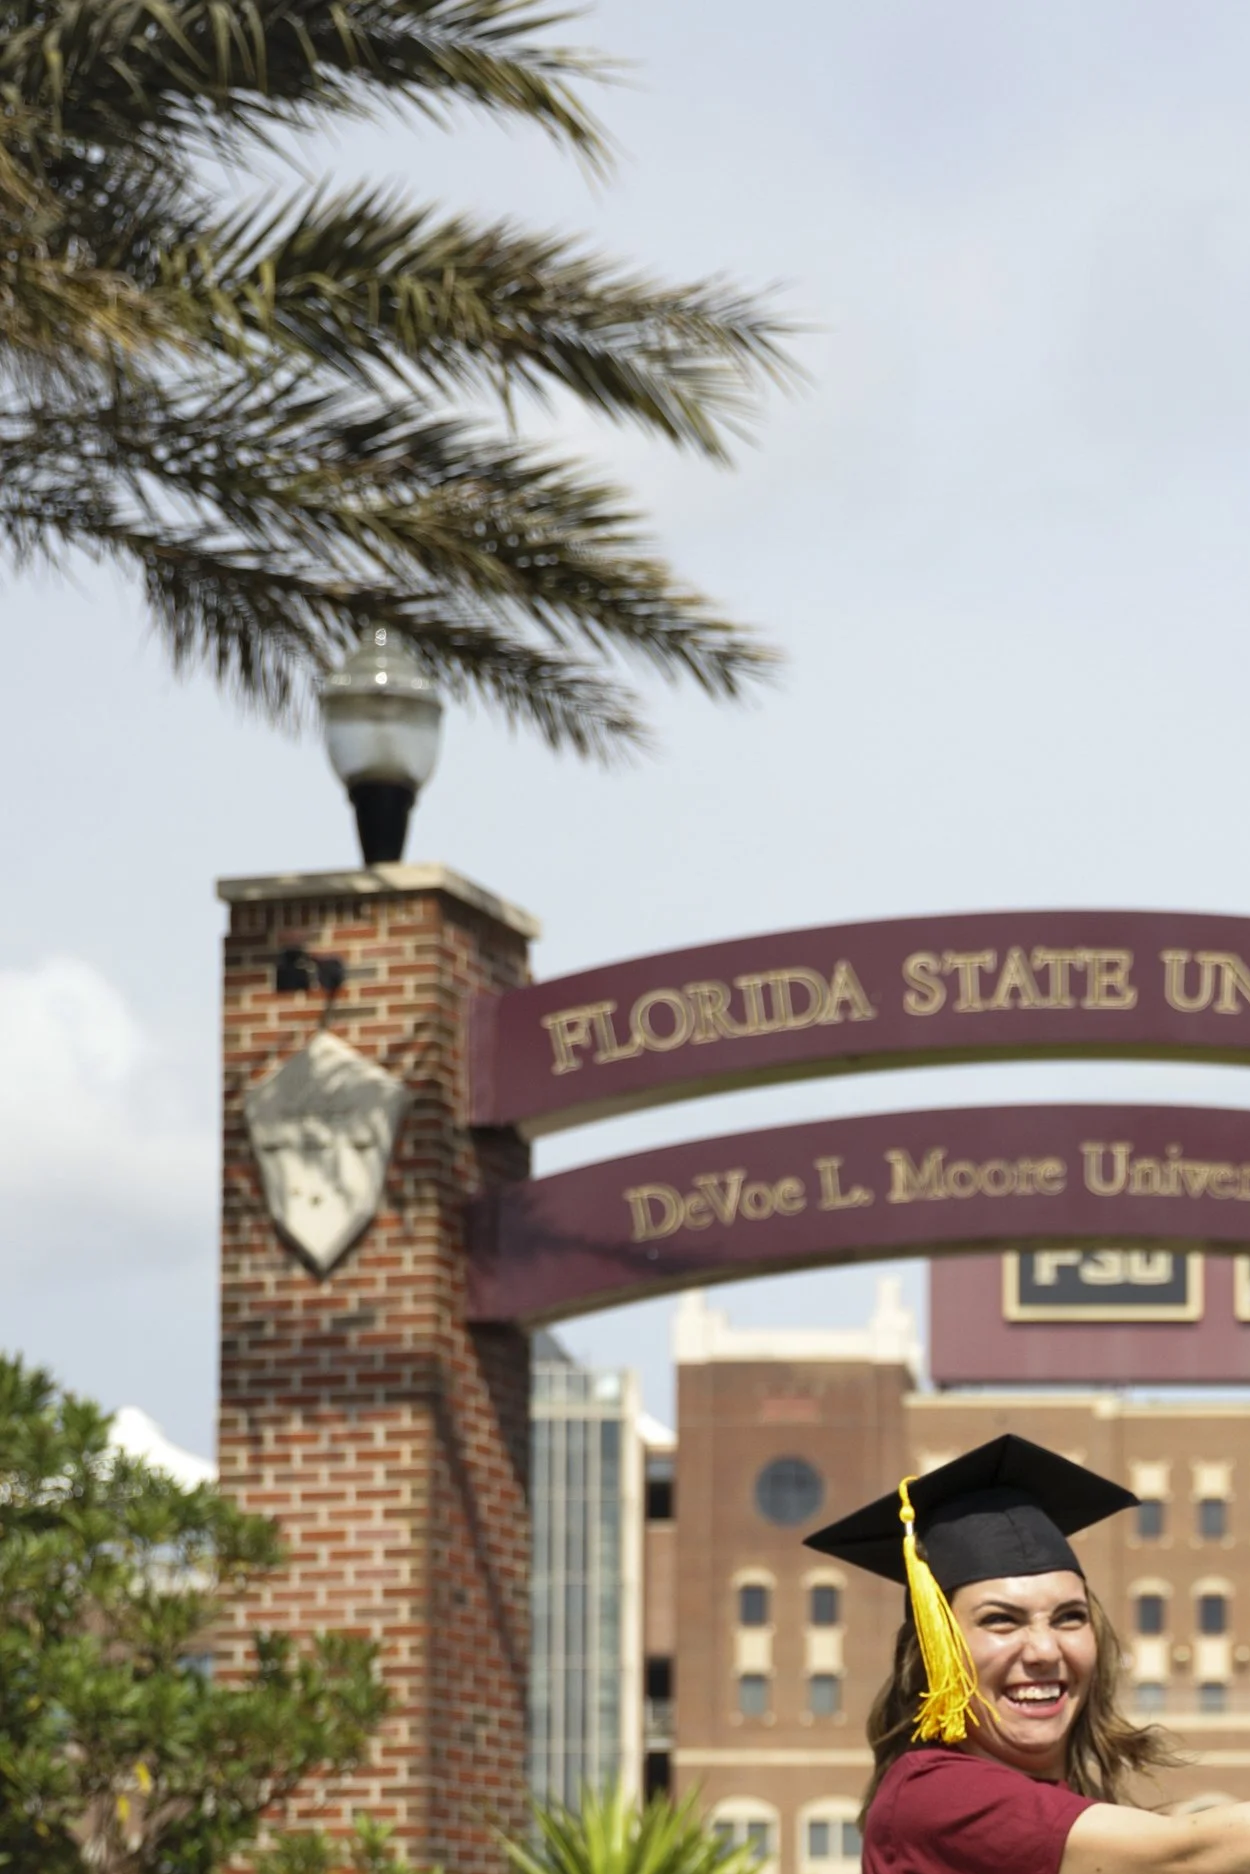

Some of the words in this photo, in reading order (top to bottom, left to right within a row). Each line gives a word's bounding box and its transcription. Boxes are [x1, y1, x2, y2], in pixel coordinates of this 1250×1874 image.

[542, 961, 876, 1074] FLORIDA
[903, 947, 1138, 1015] STATE
[624, 1170, 806, 1242] DeVoe
[814, 1156, 873, 1210] L.
[885, 1147, 1068, 1204] Moore
